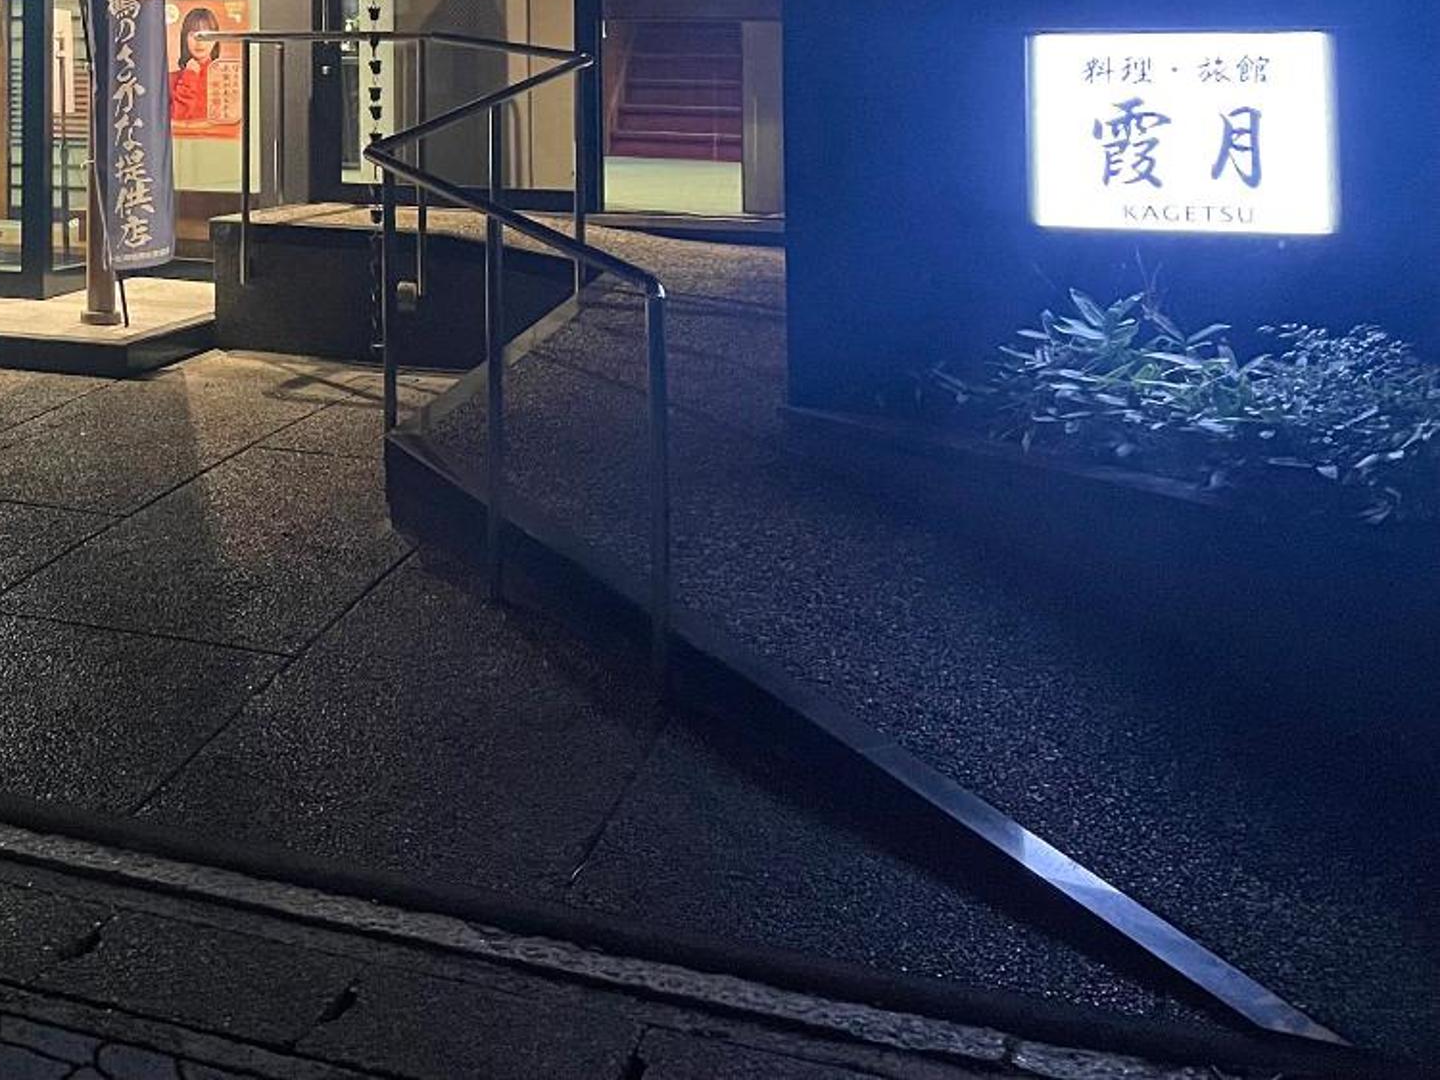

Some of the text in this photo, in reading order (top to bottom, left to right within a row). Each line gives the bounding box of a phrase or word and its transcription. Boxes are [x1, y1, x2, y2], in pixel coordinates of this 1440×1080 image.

[1084, 55, 1271, 84] 料理・旅館
[1092, 97, 1263, 189] 霞月
[1123, 204, 1257, 223] KAGETSU
